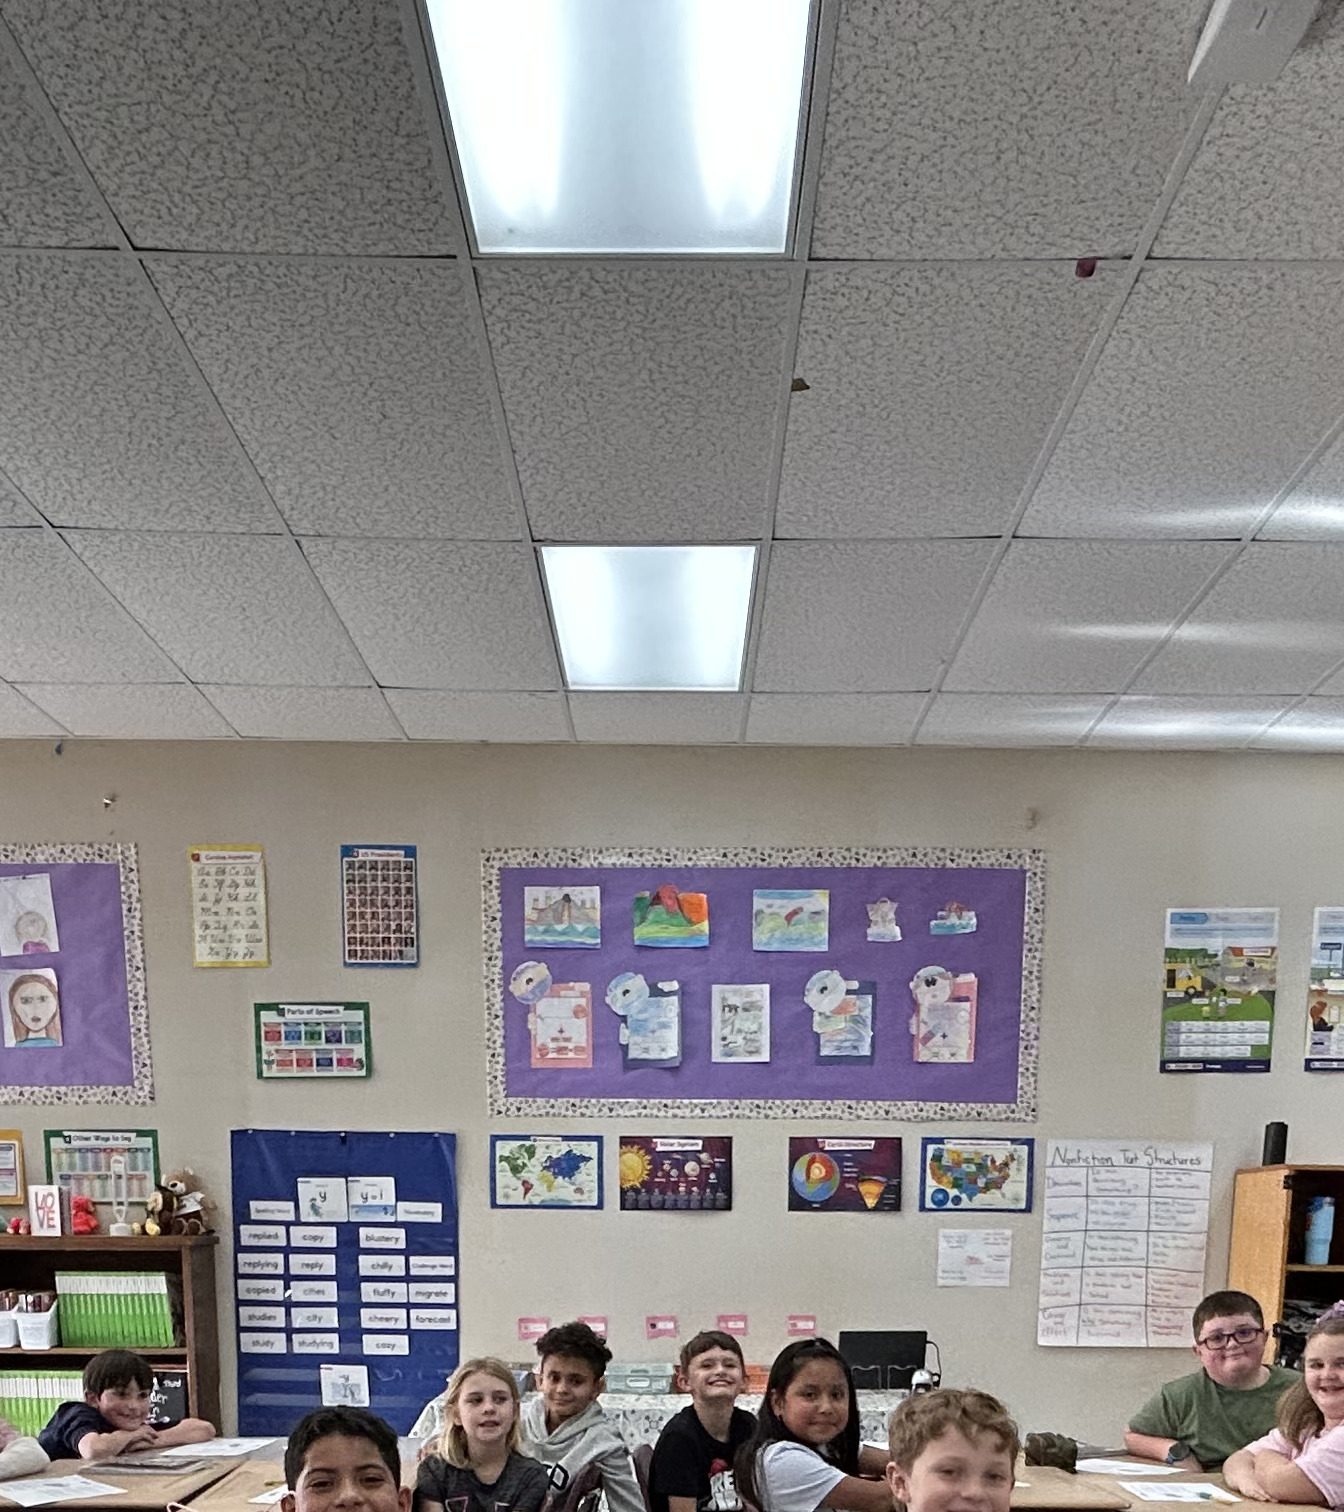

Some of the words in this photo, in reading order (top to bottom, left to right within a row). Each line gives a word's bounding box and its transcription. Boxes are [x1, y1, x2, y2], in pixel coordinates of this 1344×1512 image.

[315, 1008, 340, 1016] Speech
[1052, 1146, 1115, 1167] Nonfiction
[1119, 1149, 1139, 1165] Text
[1144, 1146, 1201, 1166] Structures
[319, 1191, 327, 1203] y
[360, 1192, 369, 1204] y
[248, 1231, 279, 1240] replied
[302, 1234, 324, 1243] copy
[365, 1234, 400, 1245] blustery
[243, 1260, 279, 1270] replying
[301, 1261, 324, 1271] reply
[371, 1261, 393, 1272] chilly
[245, 1286, 276, 1296] copied
[373, 1288, 396, 1299] fluffy
[416, 1289, 448, 1299] migrate
[248, 1313, 276, 1321] studies
[306, 1313, 323, 1324] city
[416, 1314, 451, 1323] forecast
[251, 1339, 275, 1349] study
[298, 1339, 334, 1350] studying
[376, 1342, 396, 1351] cozy
